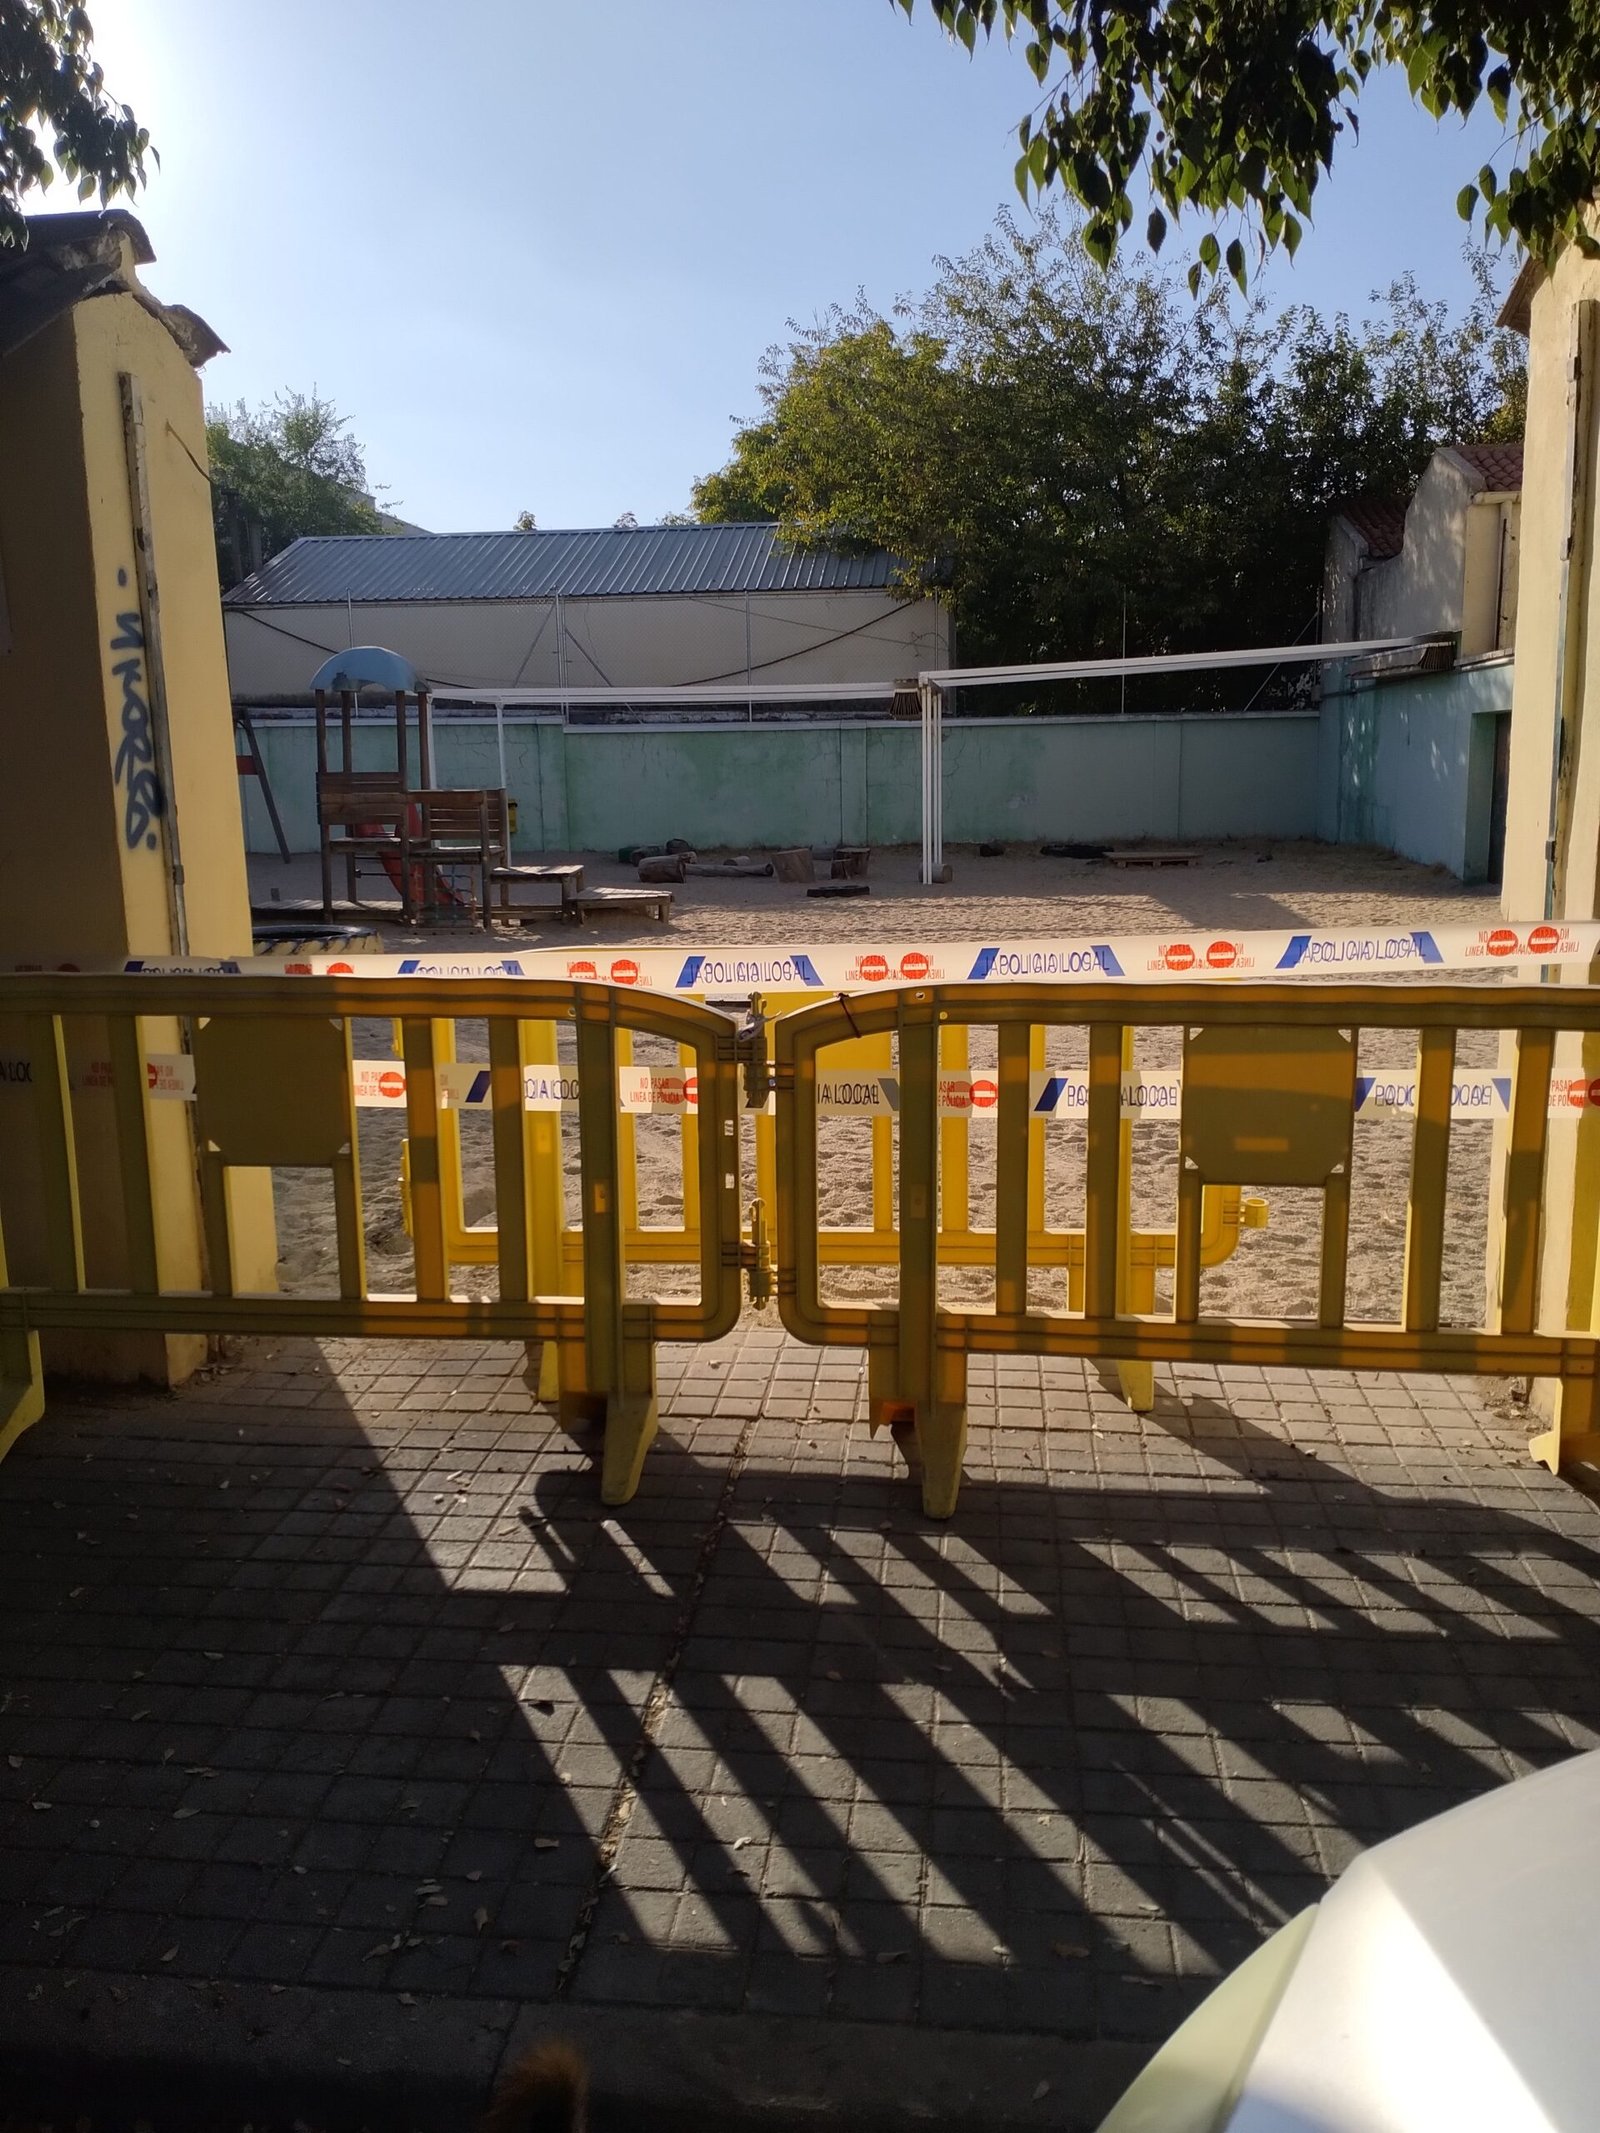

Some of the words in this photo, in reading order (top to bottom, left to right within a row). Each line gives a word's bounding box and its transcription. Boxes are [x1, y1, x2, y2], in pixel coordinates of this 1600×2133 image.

[1478, 931, 1488, 943] NO
[1465, 944, 1484, 957] LINEA
[640, 1077, 648, 1090] NO
[1551, 1079, 1573, 1092] PASAR
[630, 1090, 647, 1103] LINEA
